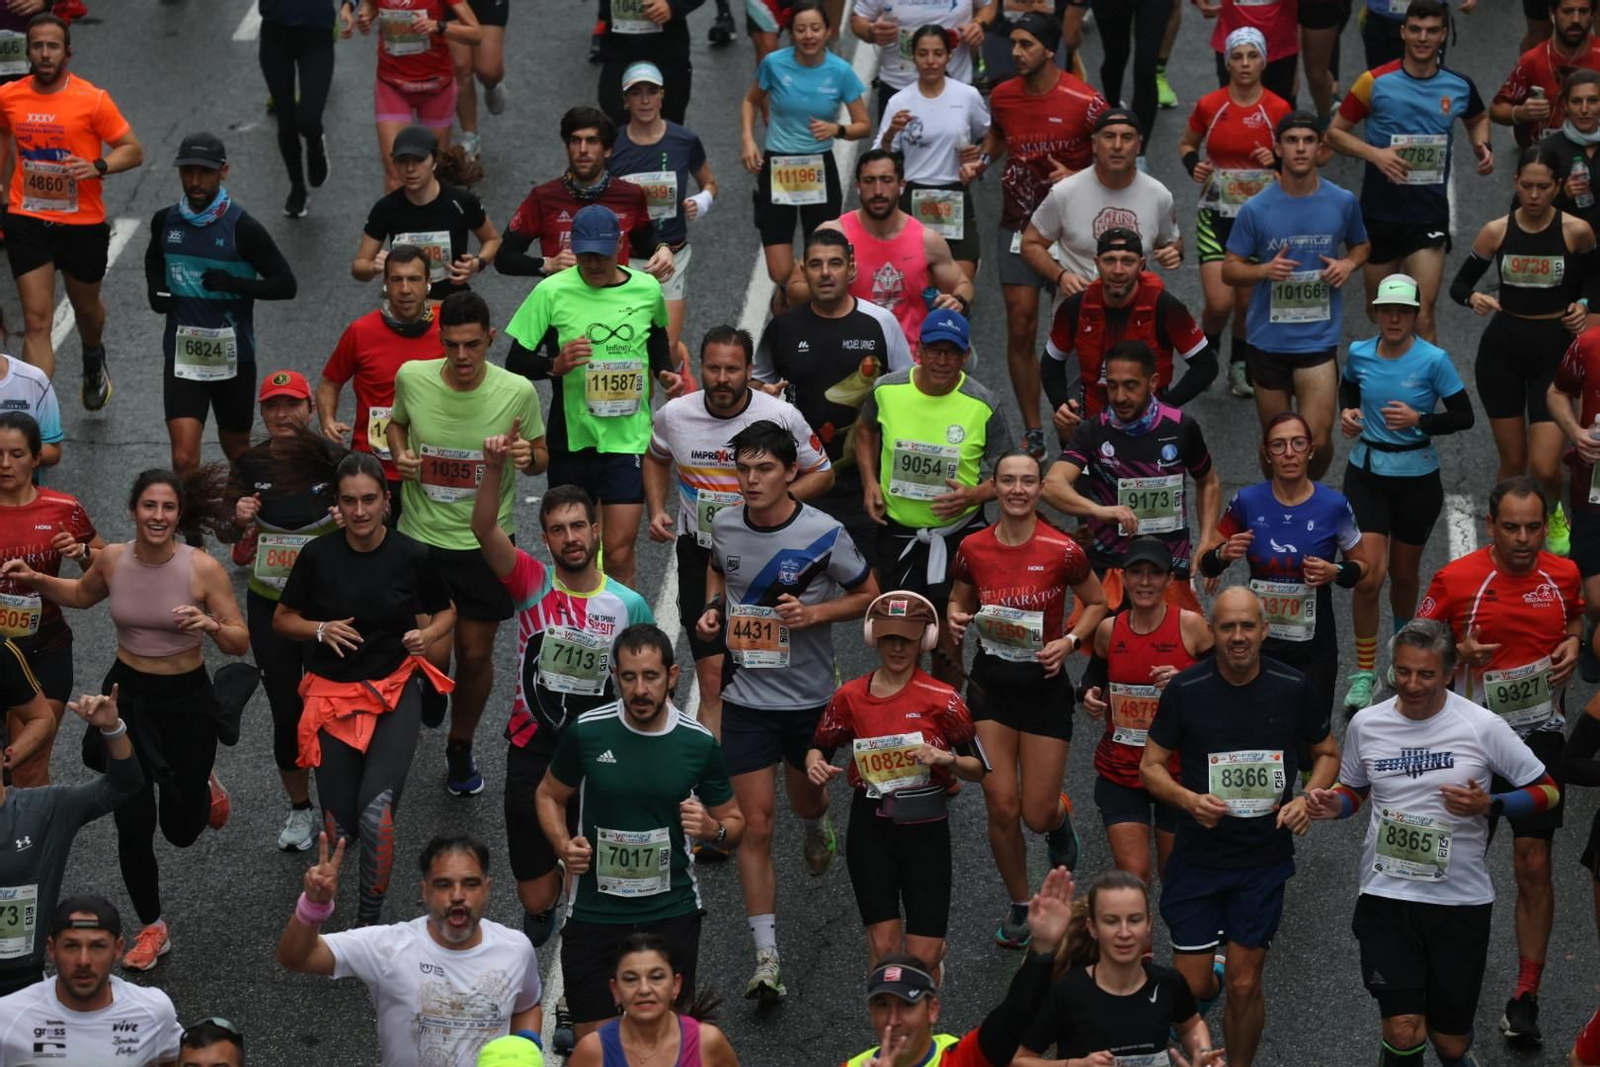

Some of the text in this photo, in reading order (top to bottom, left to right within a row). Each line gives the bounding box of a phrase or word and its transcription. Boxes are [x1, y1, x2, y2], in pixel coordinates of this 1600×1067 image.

[27, 112, 56, 124] XXXV
[29, 174, 64, 192] 4860
[776, 169, 816, 184] 11196
[1511, 257, 1550, 275] 9738
[1276, 281, 1321, 301] 10166
[185, 339, 223, 358] 6824
[592, 374, 637, 392] 11587
[374, 421, 387, 437] 1
[430, 461, 472, 480] 1035
[901, 455, 943, 477] 9054
[1128, 491, 1170, 510] 9173
[733, 620, 772, 642] 4431
[553, 642, 595, 671] 7113
[1496, 677, 1540, 705] 9327
[860, 748, 917, 775] 10829
[1222, 767, 1268, 789] 8366
[1386, 825, 1433, 853] 8365
[608, 846, 654, 868] 7017
[112, 1020, 139, 1032] vive
